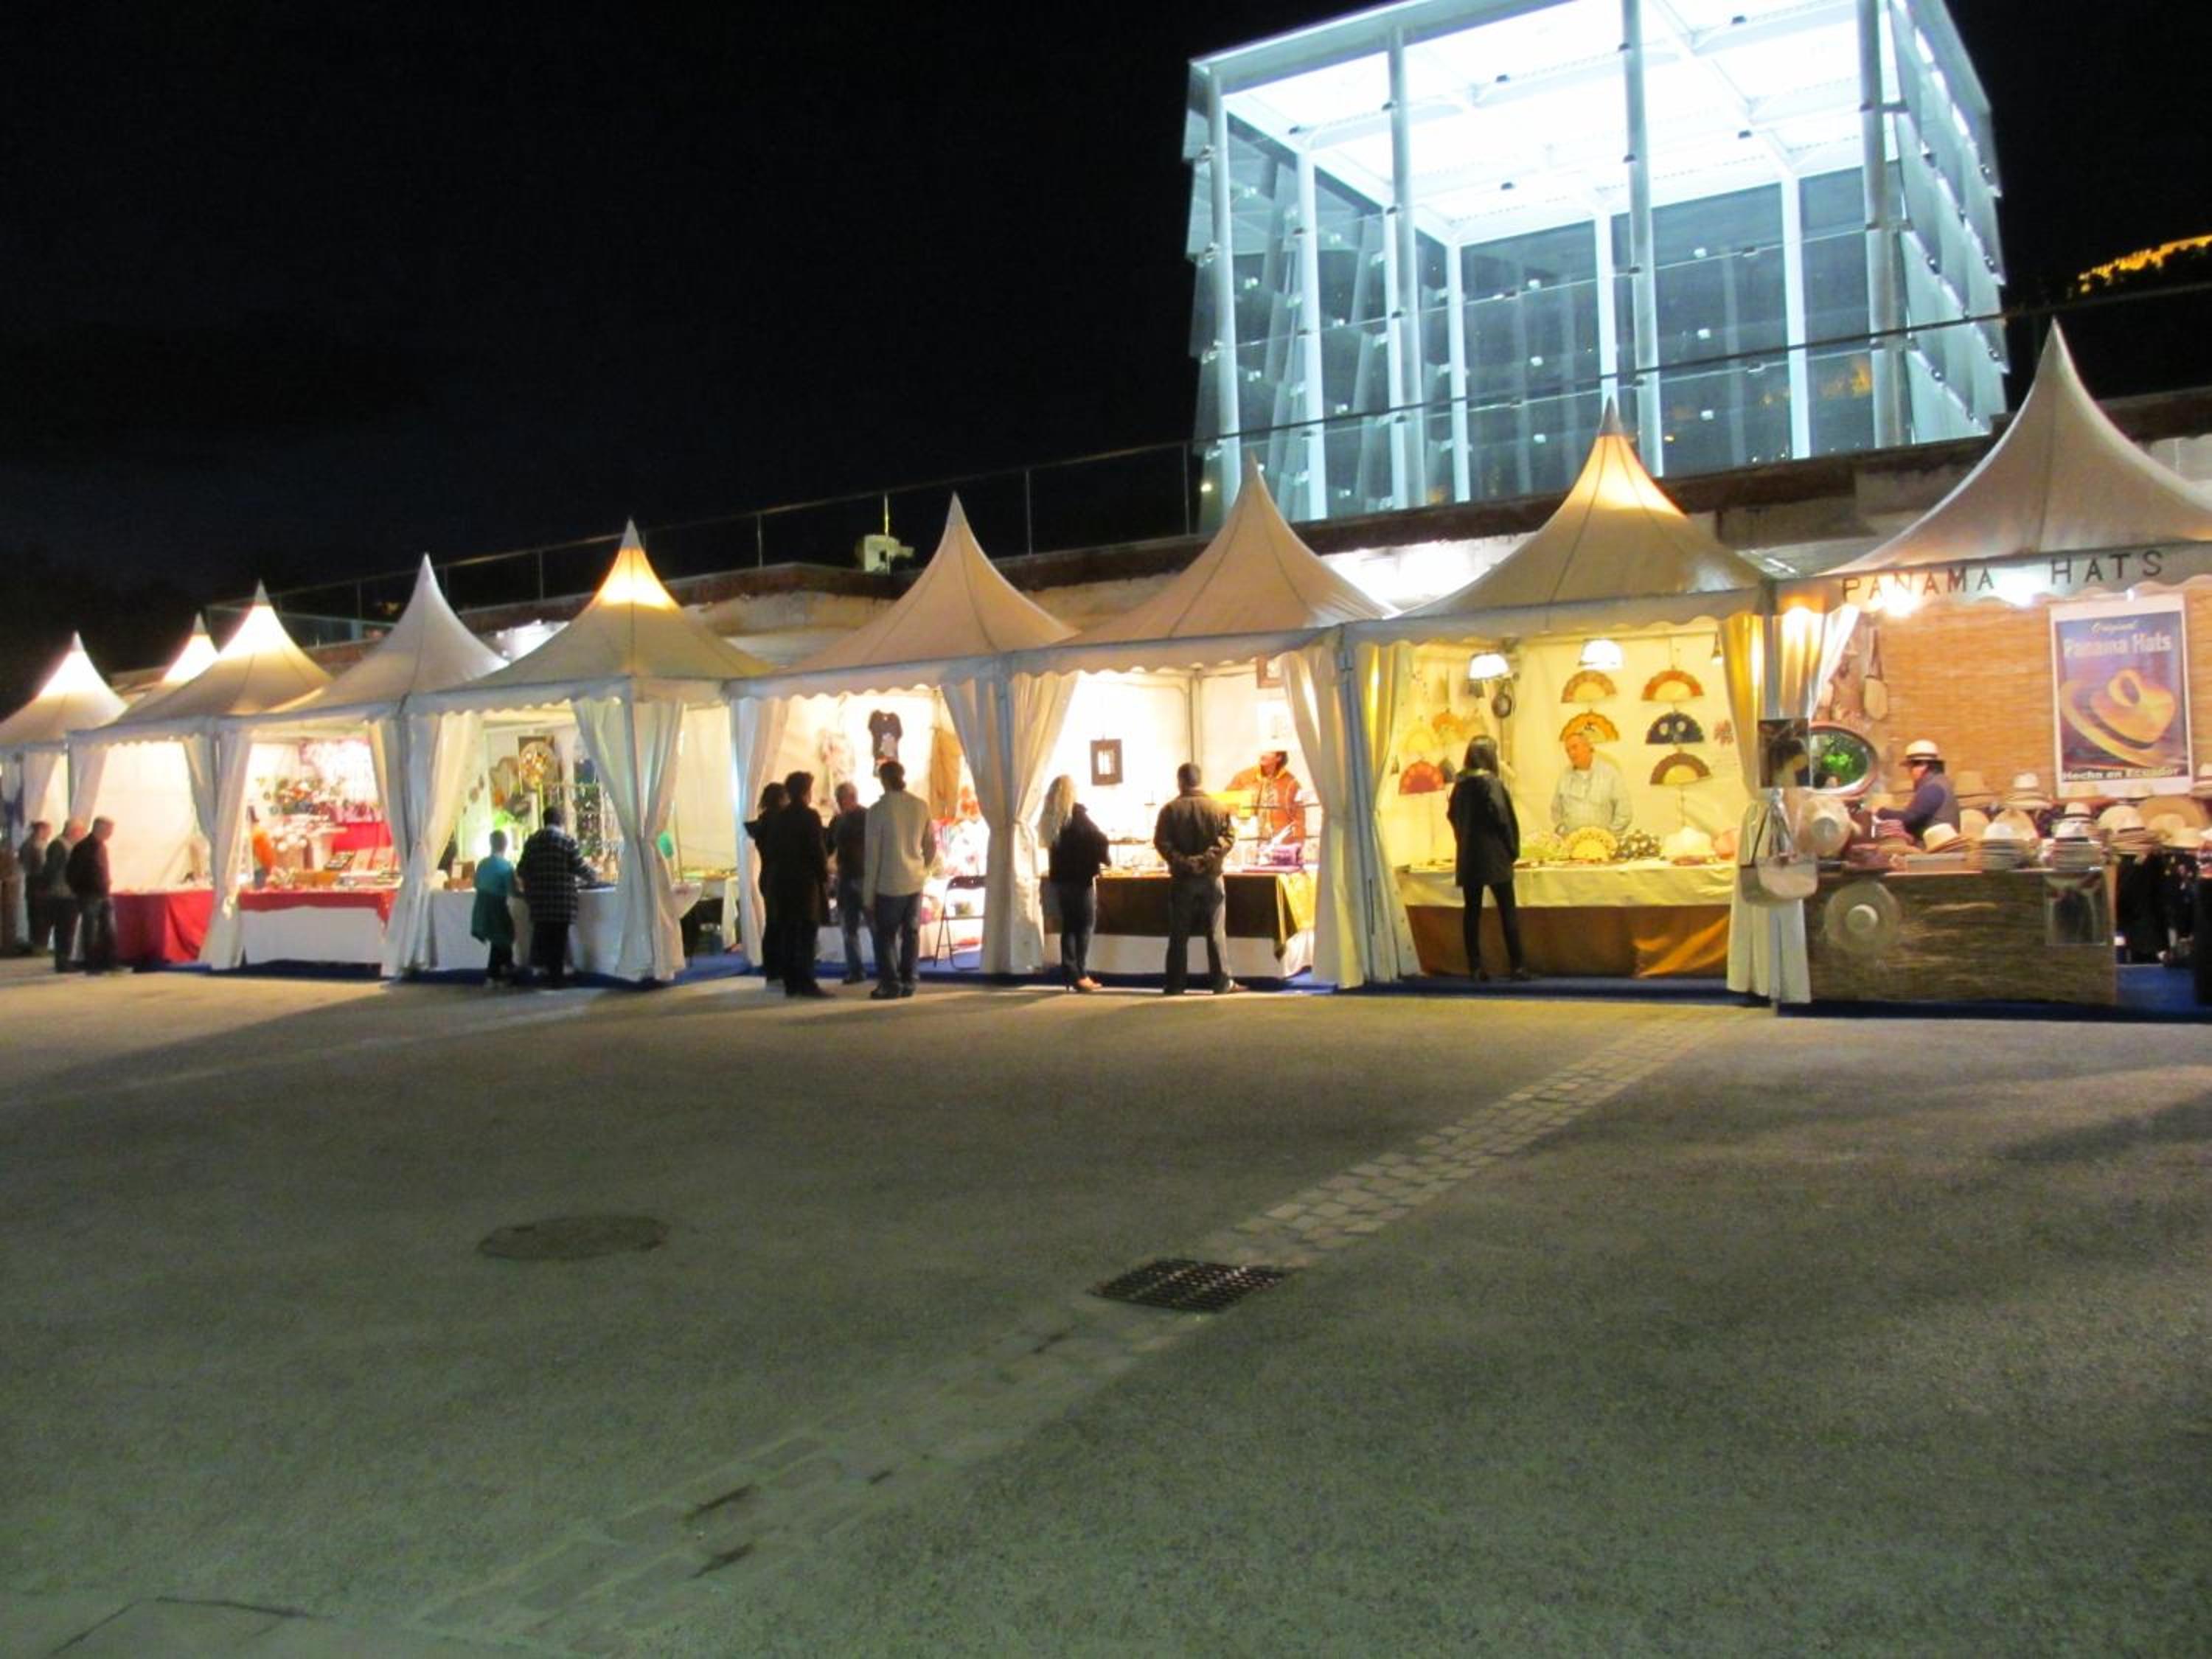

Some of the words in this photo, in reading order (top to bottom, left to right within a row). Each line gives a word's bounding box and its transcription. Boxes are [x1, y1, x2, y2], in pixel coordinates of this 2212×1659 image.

[1841, 565, 1994, 603] PANAMA
[2050, 549, 2163, 585] HATS
[2064, 637, 2129, 659] Panama
[2132, 631, 2172, 653] Hats
